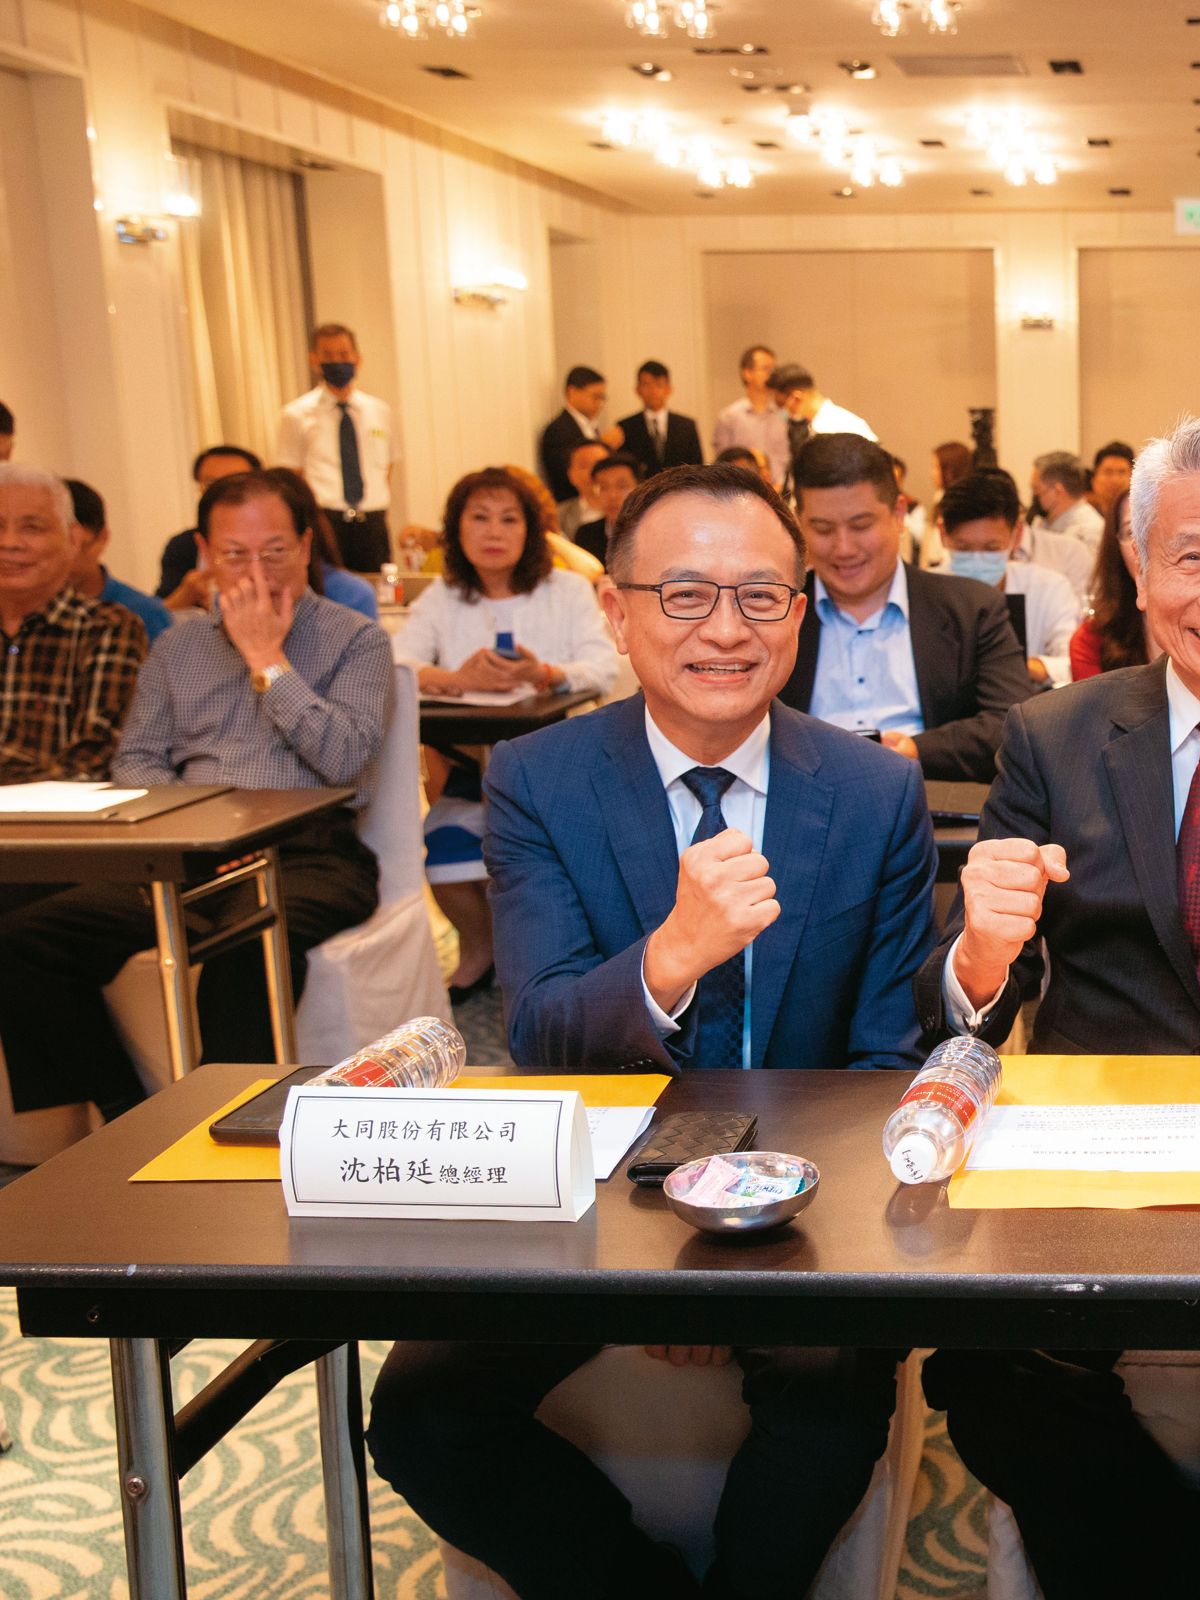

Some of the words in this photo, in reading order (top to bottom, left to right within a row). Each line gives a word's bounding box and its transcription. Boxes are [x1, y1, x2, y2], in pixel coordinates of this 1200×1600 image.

[331, 1118, 517, 1142] 大同股份有限公司
[340, 1157, 507, 1184] 沈柏延總經理
